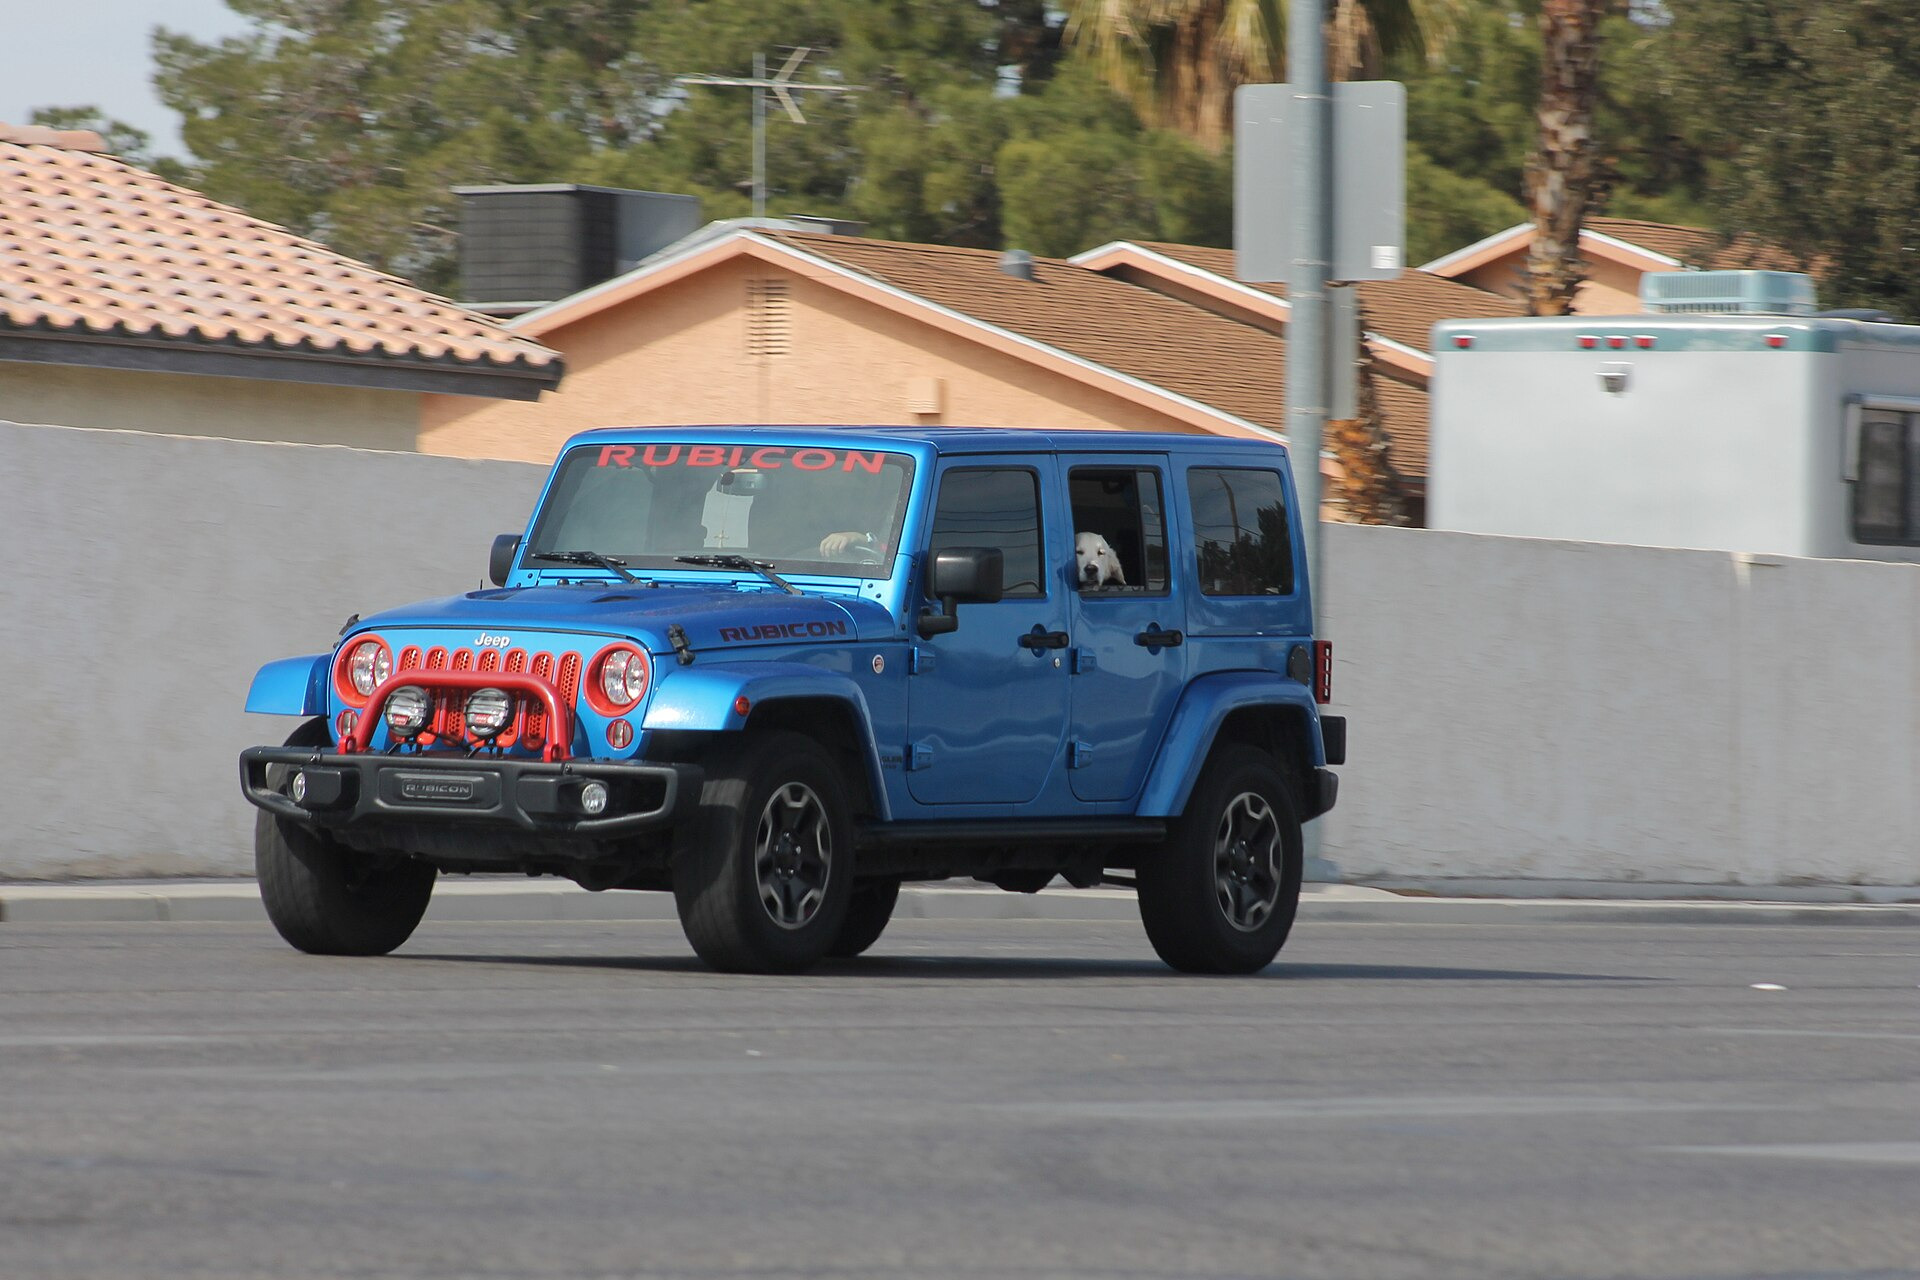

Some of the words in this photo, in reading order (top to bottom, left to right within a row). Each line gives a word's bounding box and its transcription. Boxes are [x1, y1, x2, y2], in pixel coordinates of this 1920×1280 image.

[597, 445, 886, 473] RUBICON
[474, 632, 511, 649] Jeep
[719, 620, 847, 642] RUBICON
[405, 783, 470, 793] RUBICON
